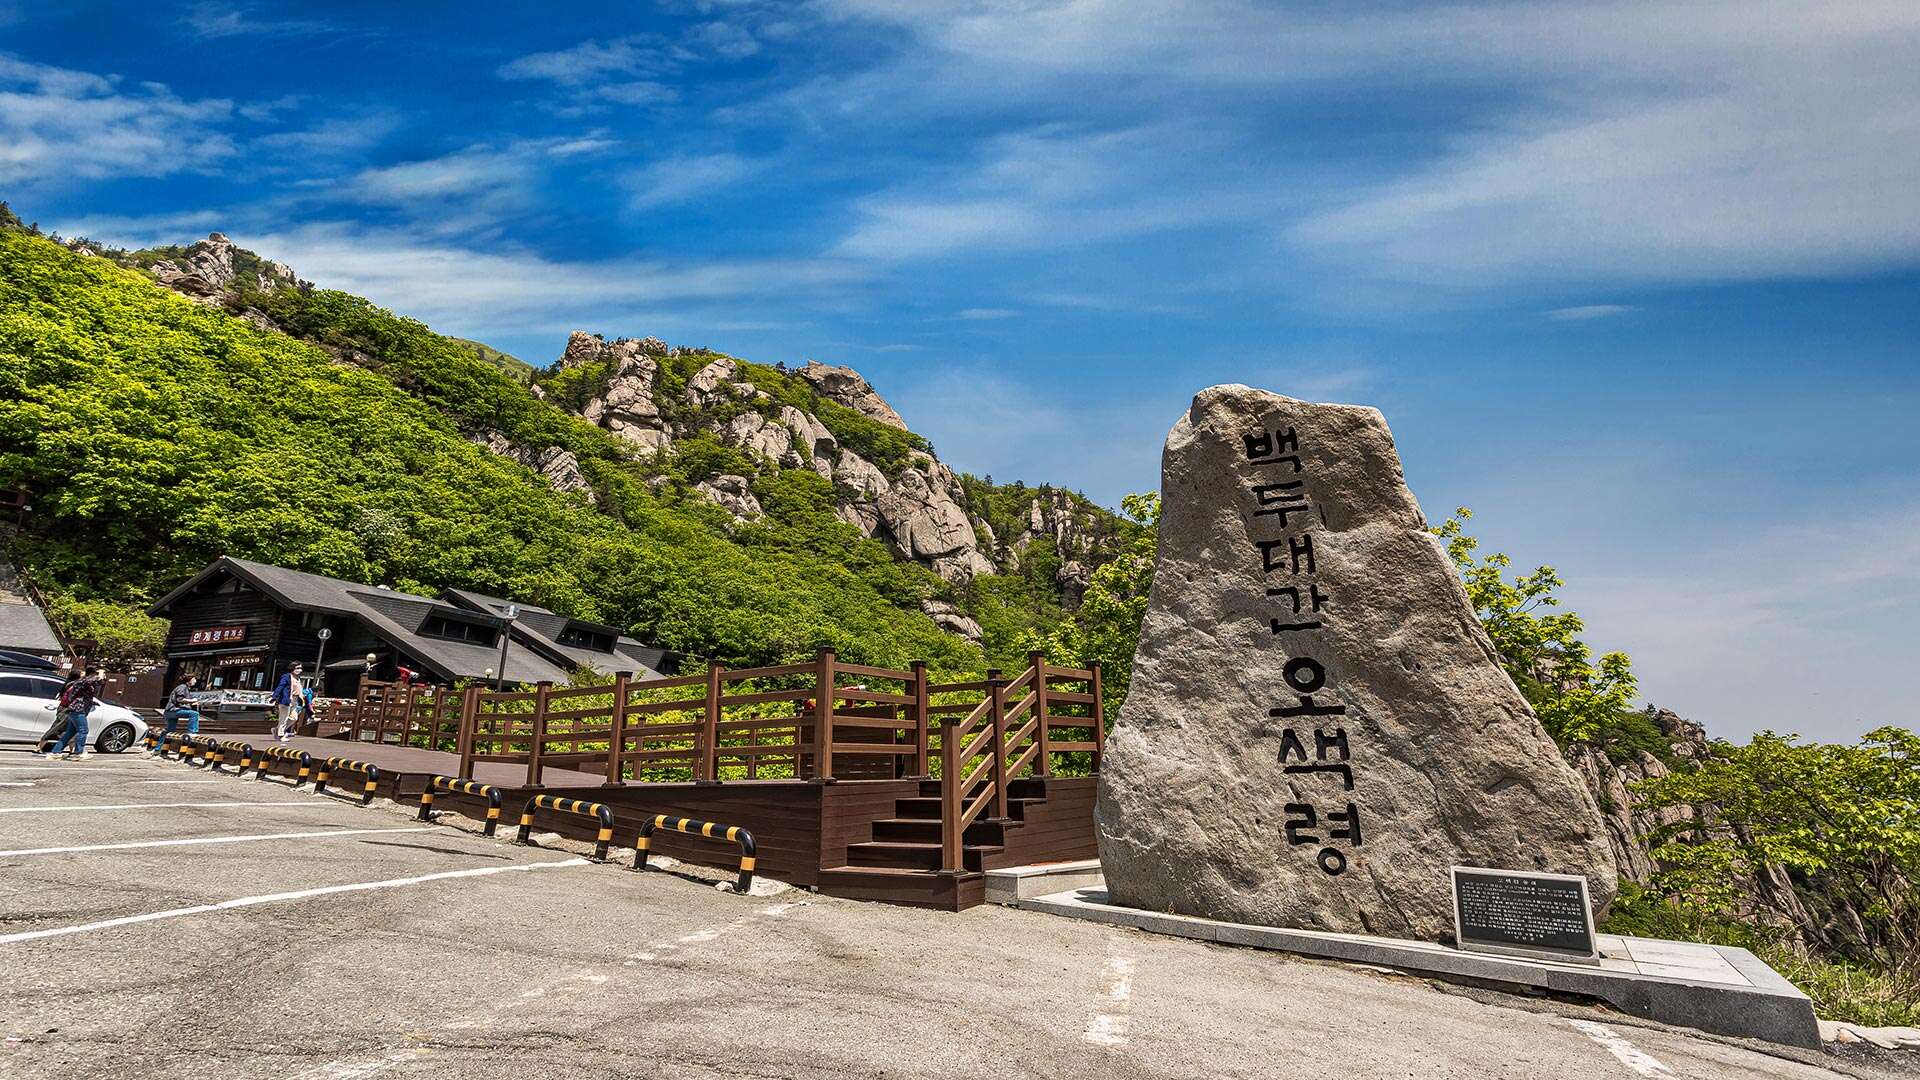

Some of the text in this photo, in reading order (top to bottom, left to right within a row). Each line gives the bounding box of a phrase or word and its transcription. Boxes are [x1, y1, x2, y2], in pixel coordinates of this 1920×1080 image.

[219, 657, 260, 665] ESPRESSO
[1244, 427, 1361, 876] 백두대간 오색령
